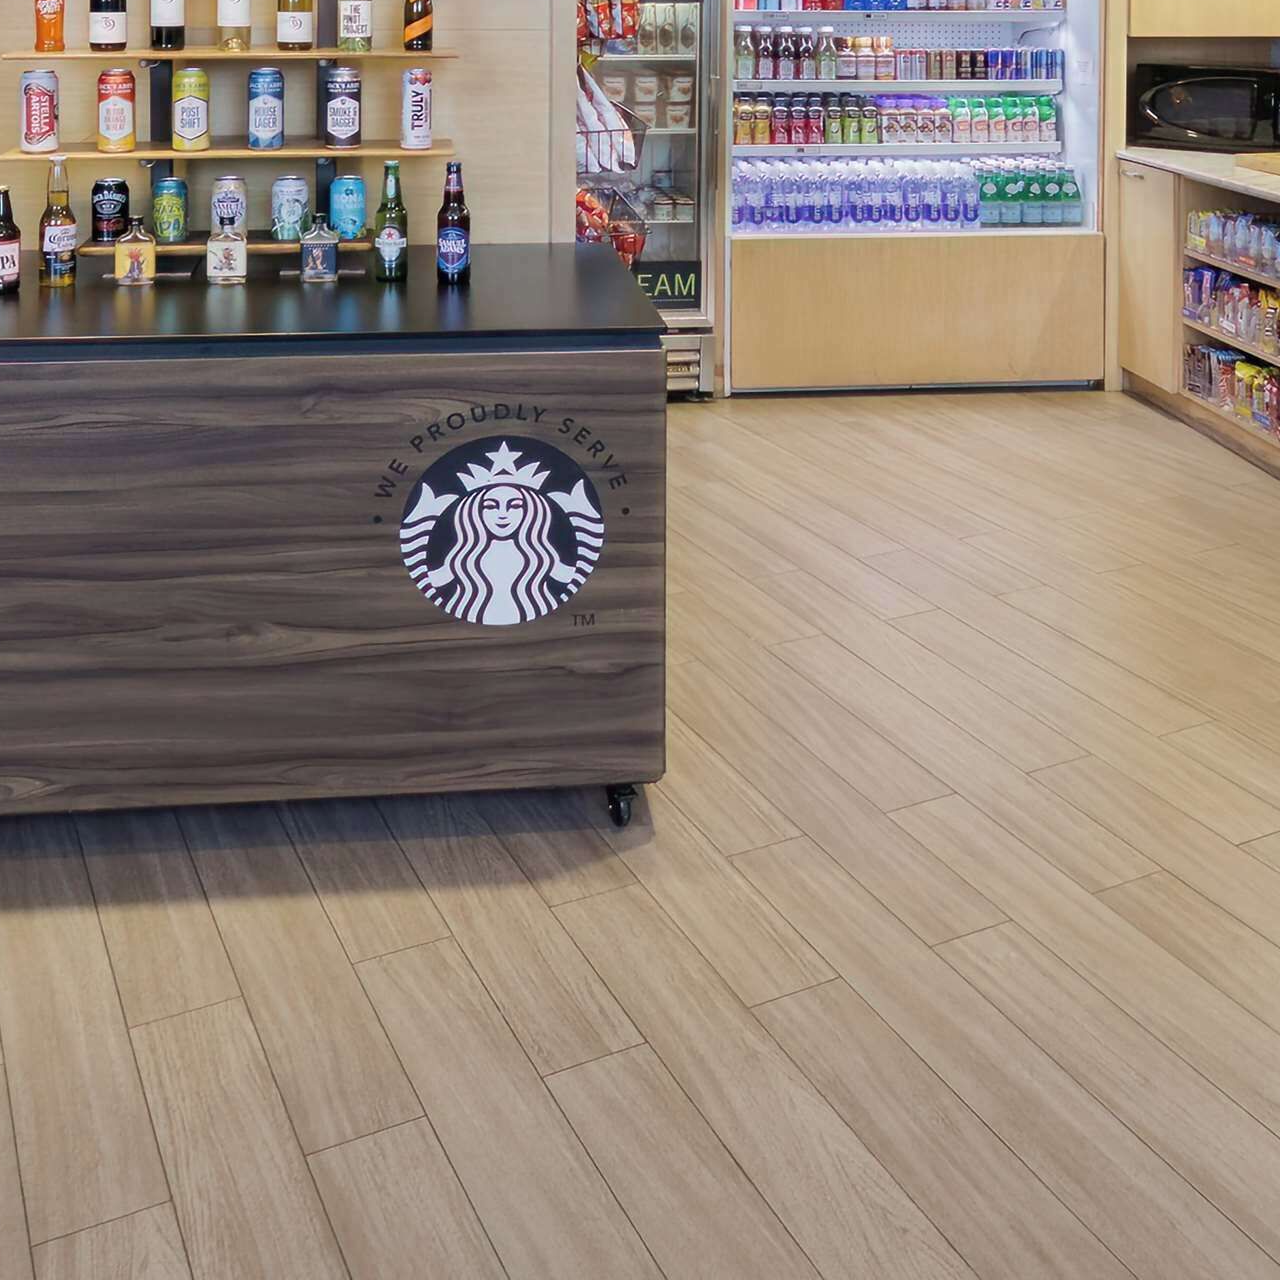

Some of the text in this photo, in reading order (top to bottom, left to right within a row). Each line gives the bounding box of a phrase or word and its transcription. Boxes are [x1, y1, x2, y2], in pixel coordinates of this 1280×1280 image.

[349, 4, 361, 14] THE
[31, 95, 40, 134] ARTOIS
[40, 95, 50, 133] STELLA
[181, 106, 199, 117] POST
[411, 90, 424, 130] TRULY
[180, 117, 200, 129] SHIFT
[254, 116, 277, 128] LAGER
[439, 237, 467, 249] SAMUEL
[374, 402, 628, 498] WE PROUDLY SERVE
[572, 614, 595, 627] TM
